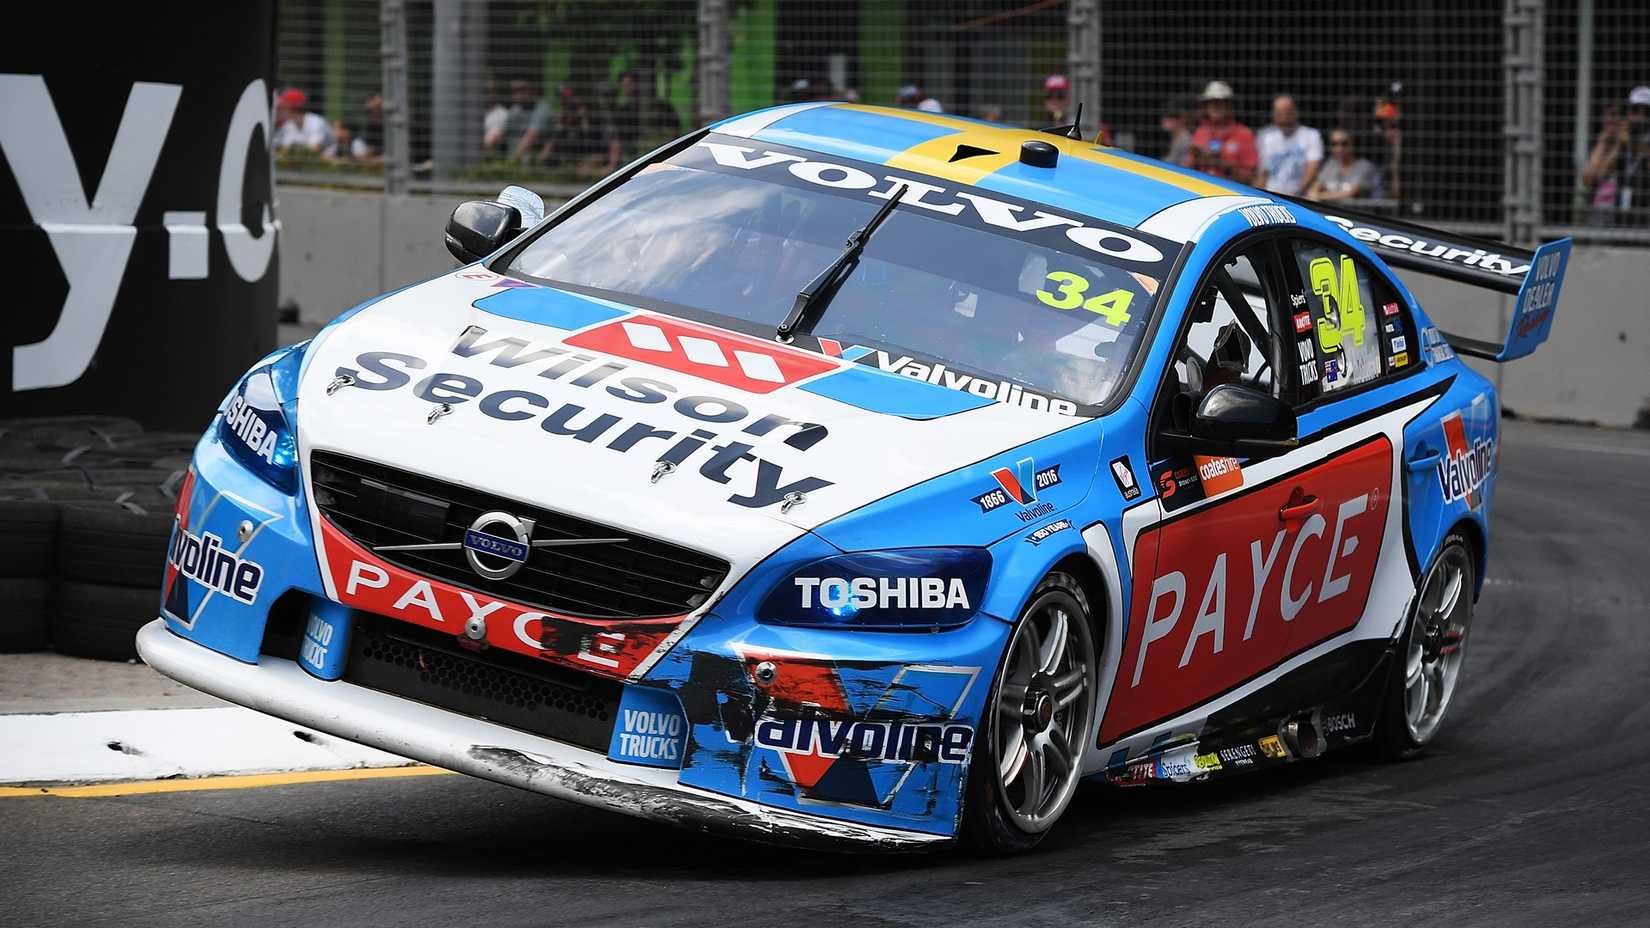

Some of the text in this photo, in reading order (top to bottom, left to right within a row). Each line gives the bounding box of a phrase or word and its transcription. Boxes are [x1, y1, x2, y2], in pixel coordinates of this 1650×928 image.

[702, 142, 1165, 263] VOLVO
[1036, 270, 1135, 327] 34
[1310, 254, 1365, 353] 34
[452, 325, 829, 452] Wilson
[877, 350, 1077, 416] Valvoline
[335, 350, 836, 509] Security
[980, 469, 1058, 510] 1866 2016
[1437, 437, 1494, 504] Valvoline
[1014, 503, 1054, 522] Valvoline
[469, 534, 523, 557] VOLVO
[795, 577, 970, 609] TOSHIBA
[1131, 493, 1369, 688] PAYCE
[620, 732, 680, 760] TRUCKS
[624, 709, 681, 737] VOLVO
